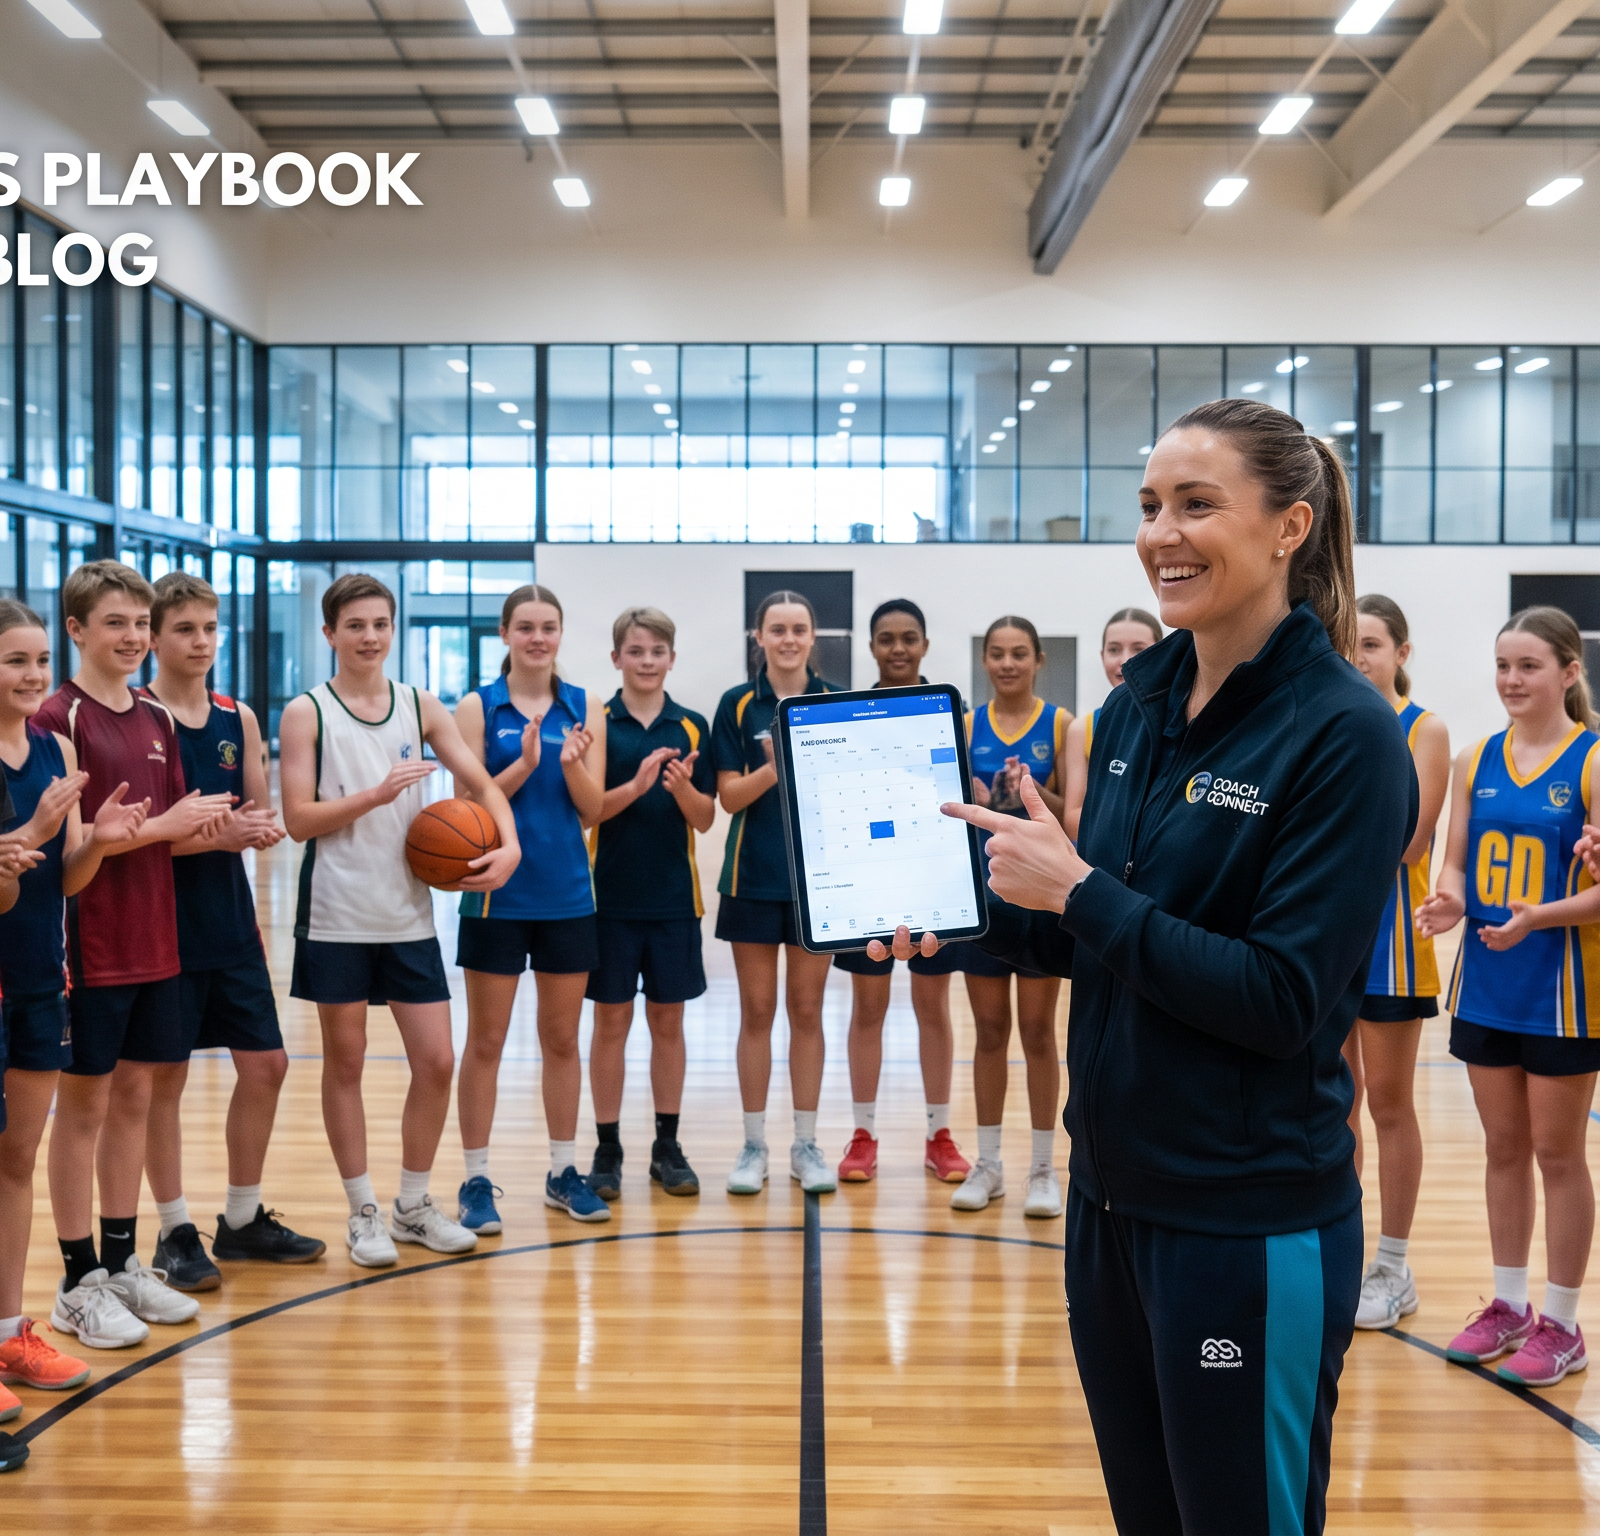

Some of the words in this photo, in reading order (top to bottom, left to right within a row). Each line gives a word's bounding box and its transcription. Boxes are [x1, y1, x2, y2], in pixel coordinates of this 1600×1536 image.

[1213, 778, 1260, 799] COACH
[1207, 790, 1270, 816] CONNECT
[1476, 830, 1545, 908] GD
